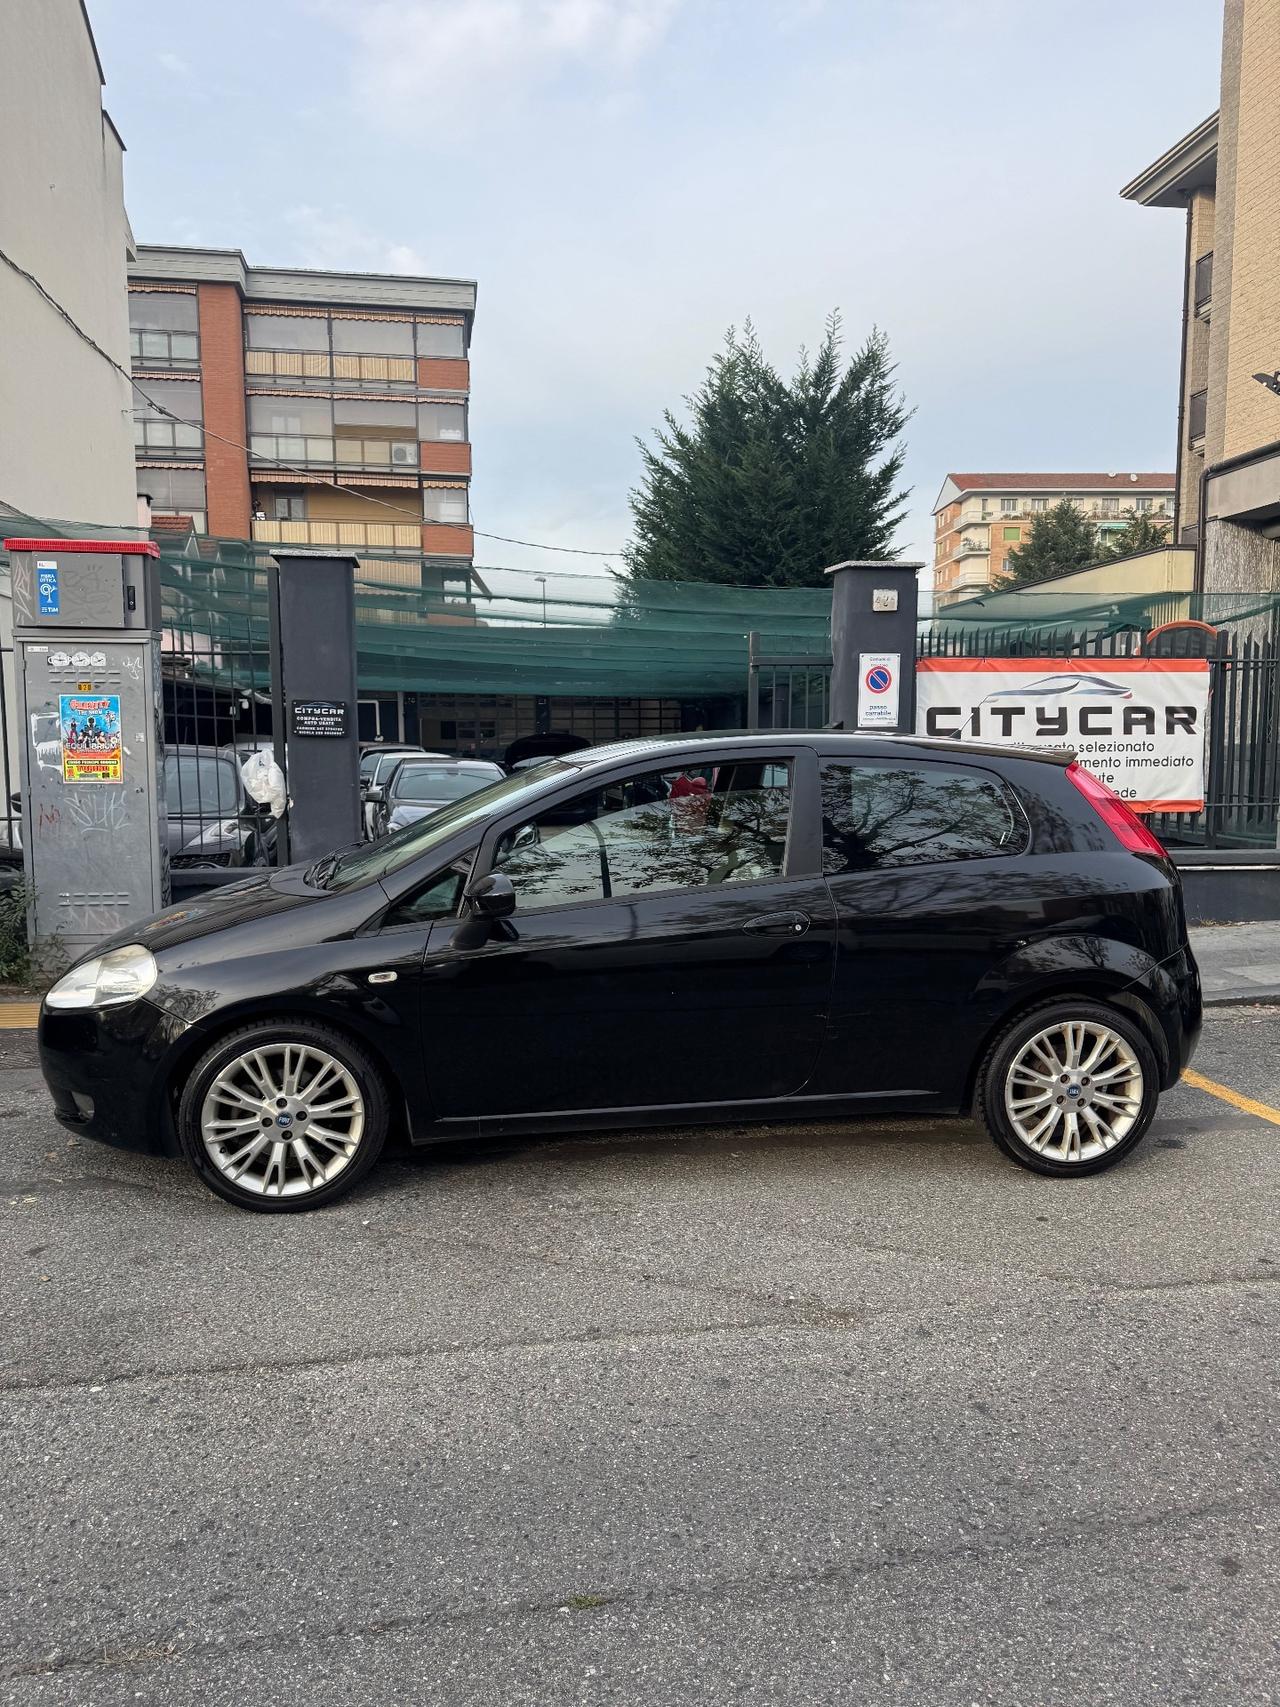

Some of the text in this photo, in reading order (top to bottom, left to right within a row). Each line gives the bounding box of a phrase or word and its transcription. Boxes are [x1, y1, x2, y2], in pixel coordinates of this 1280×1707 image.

[926, 706, 1197, 737] CITYCAR
[1078, 741, 1155, 753] selezionato
[1125, 756, 1194, 768] immediato
